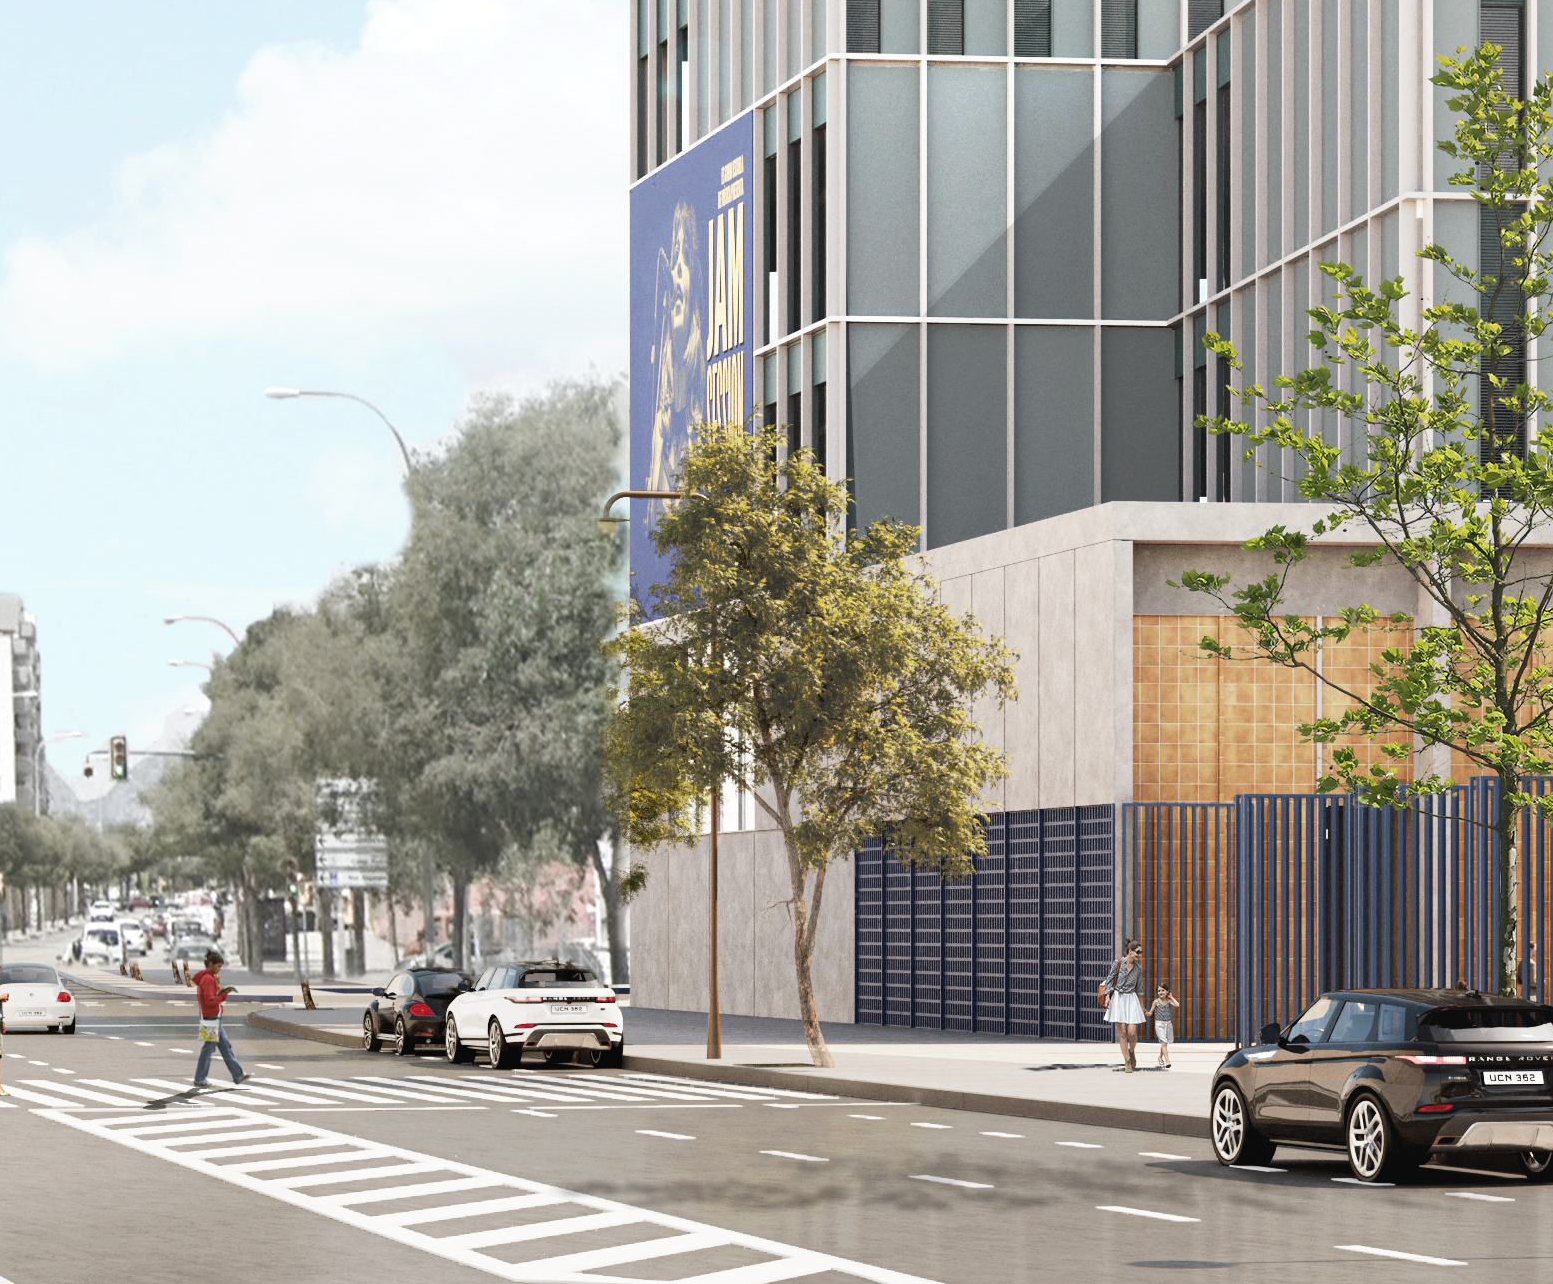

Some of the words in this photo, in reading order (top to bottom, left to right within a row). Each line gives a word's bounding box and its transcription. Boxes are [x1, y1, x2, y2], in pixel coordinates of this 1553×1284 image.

[706, 201, 744, 362] JAM
[1489, 1074, 1513, 1082] UCN
[1515, 1074, 1536, 1082] 362
